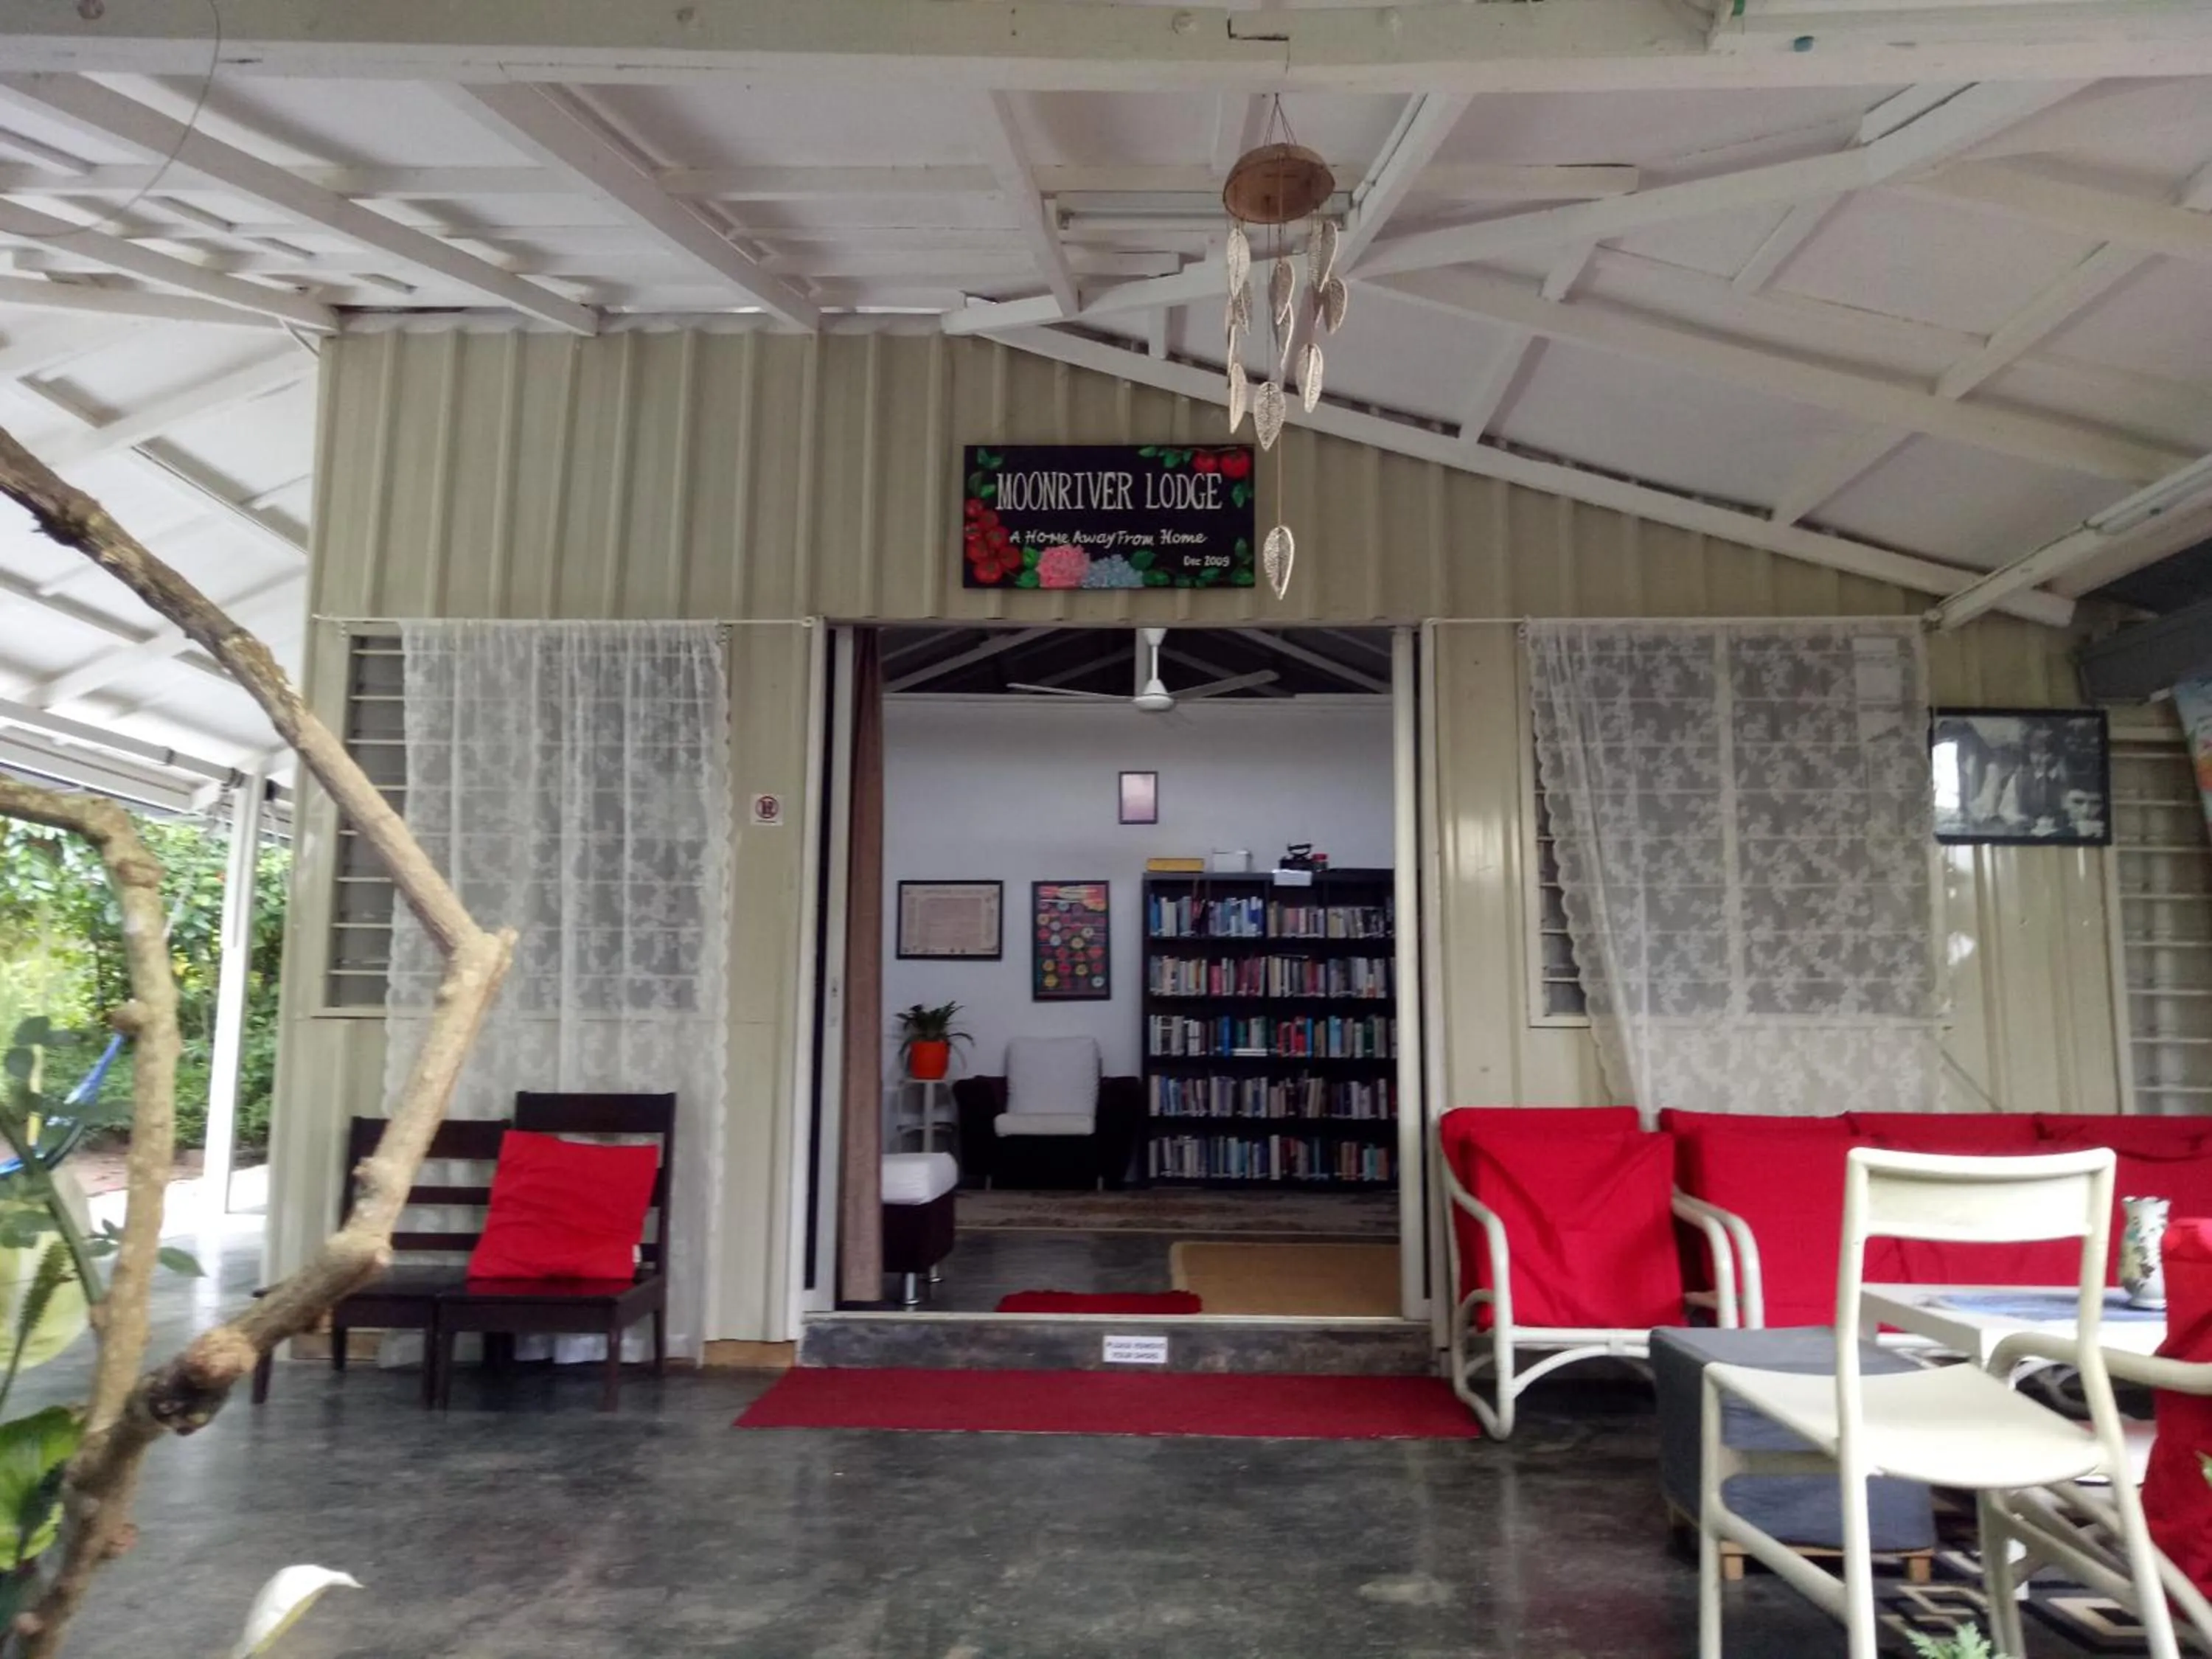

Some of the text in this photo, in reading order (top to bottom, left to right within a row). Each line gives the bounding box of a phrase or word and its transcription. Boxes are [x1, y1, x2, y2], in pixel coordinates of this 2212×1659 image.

[995, 472, 1222, 510] MOONRIVER LODGE
[1009, 531, 1020, 543] A
[1073, 530, 1116, 549] Away
[1116, 530, 1155, 546] From
[1160, 529, 1208, 545] Home
[1204, 555, 1231, 567] 2009
